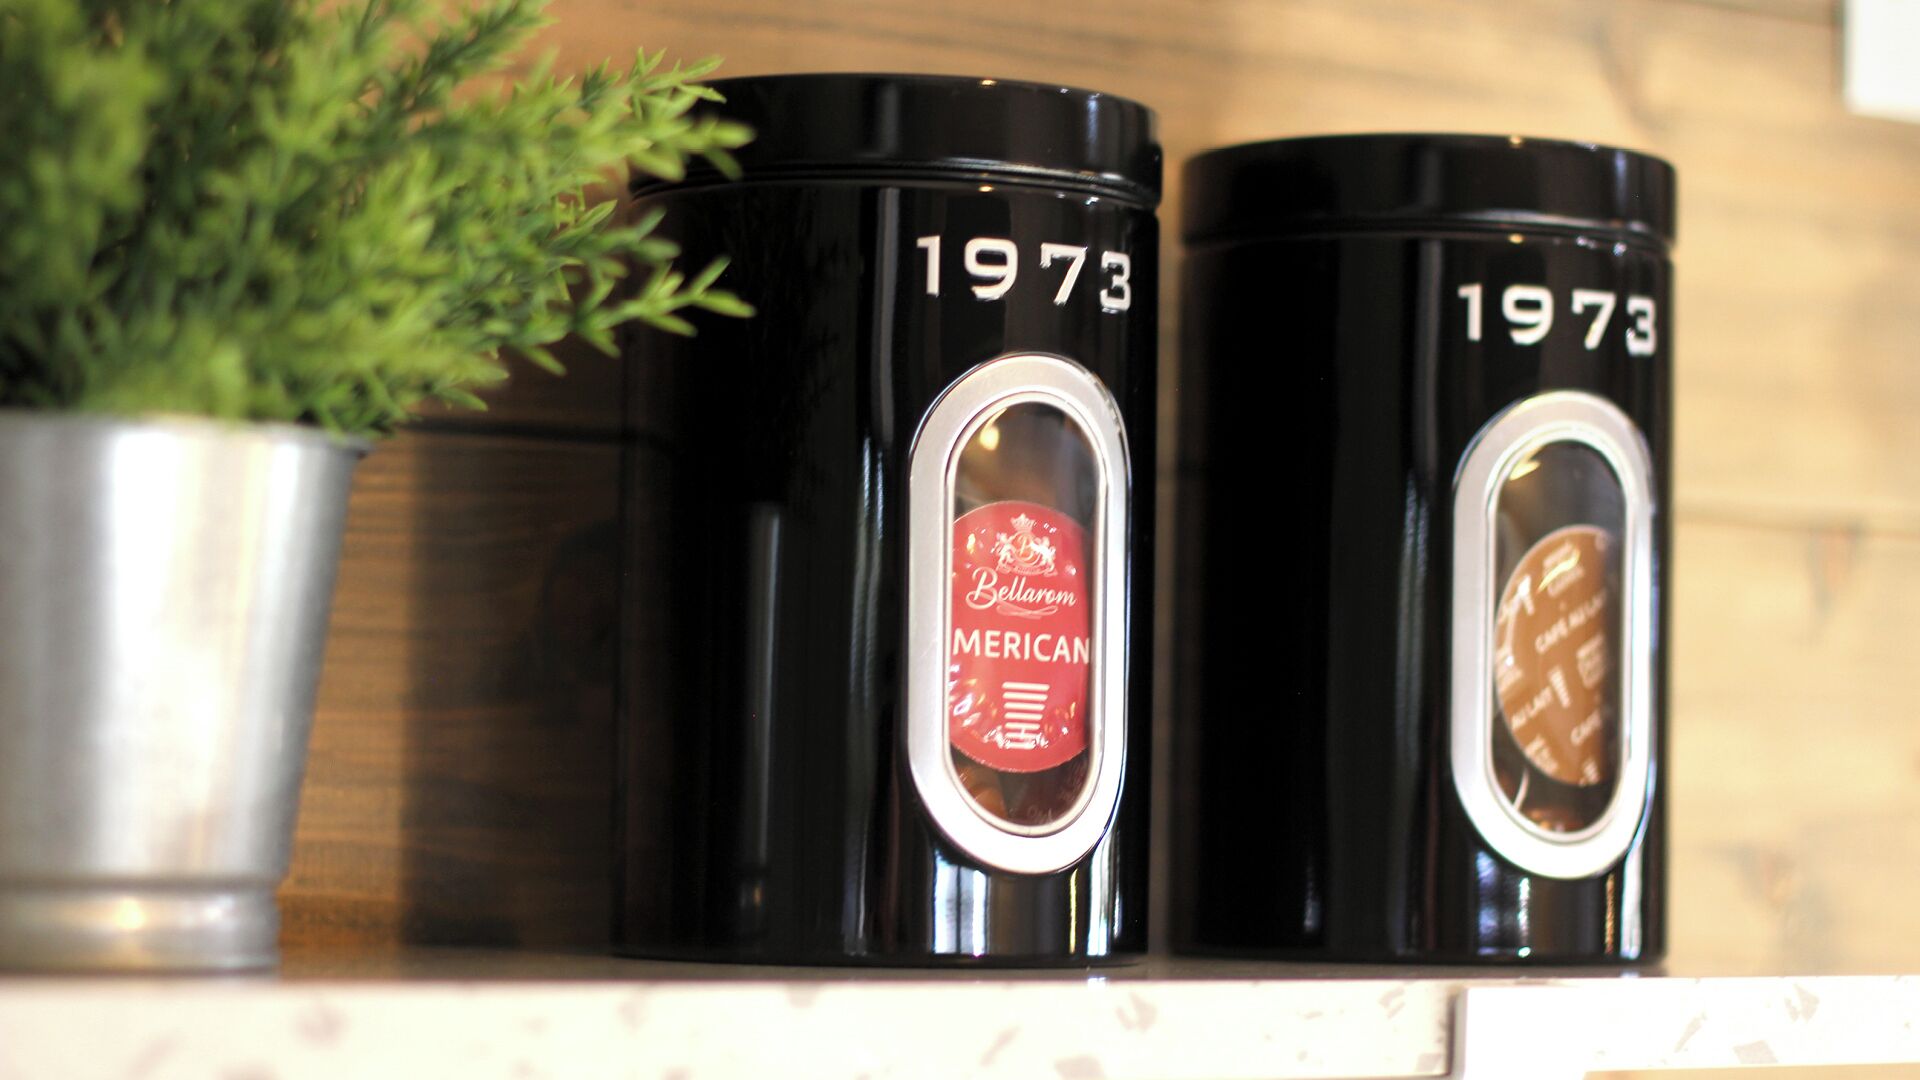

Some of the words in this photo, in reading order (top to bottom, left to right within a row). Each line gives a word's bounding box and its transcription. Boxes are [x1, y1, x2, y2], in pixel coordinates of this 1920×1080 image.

[916, 235, 1132, 314] 1973
[1457, 283, 1656, 356] 1973
[965, 566, 1077, 611] Bellarom
[952, 628, 1090, 665] MERICAN
